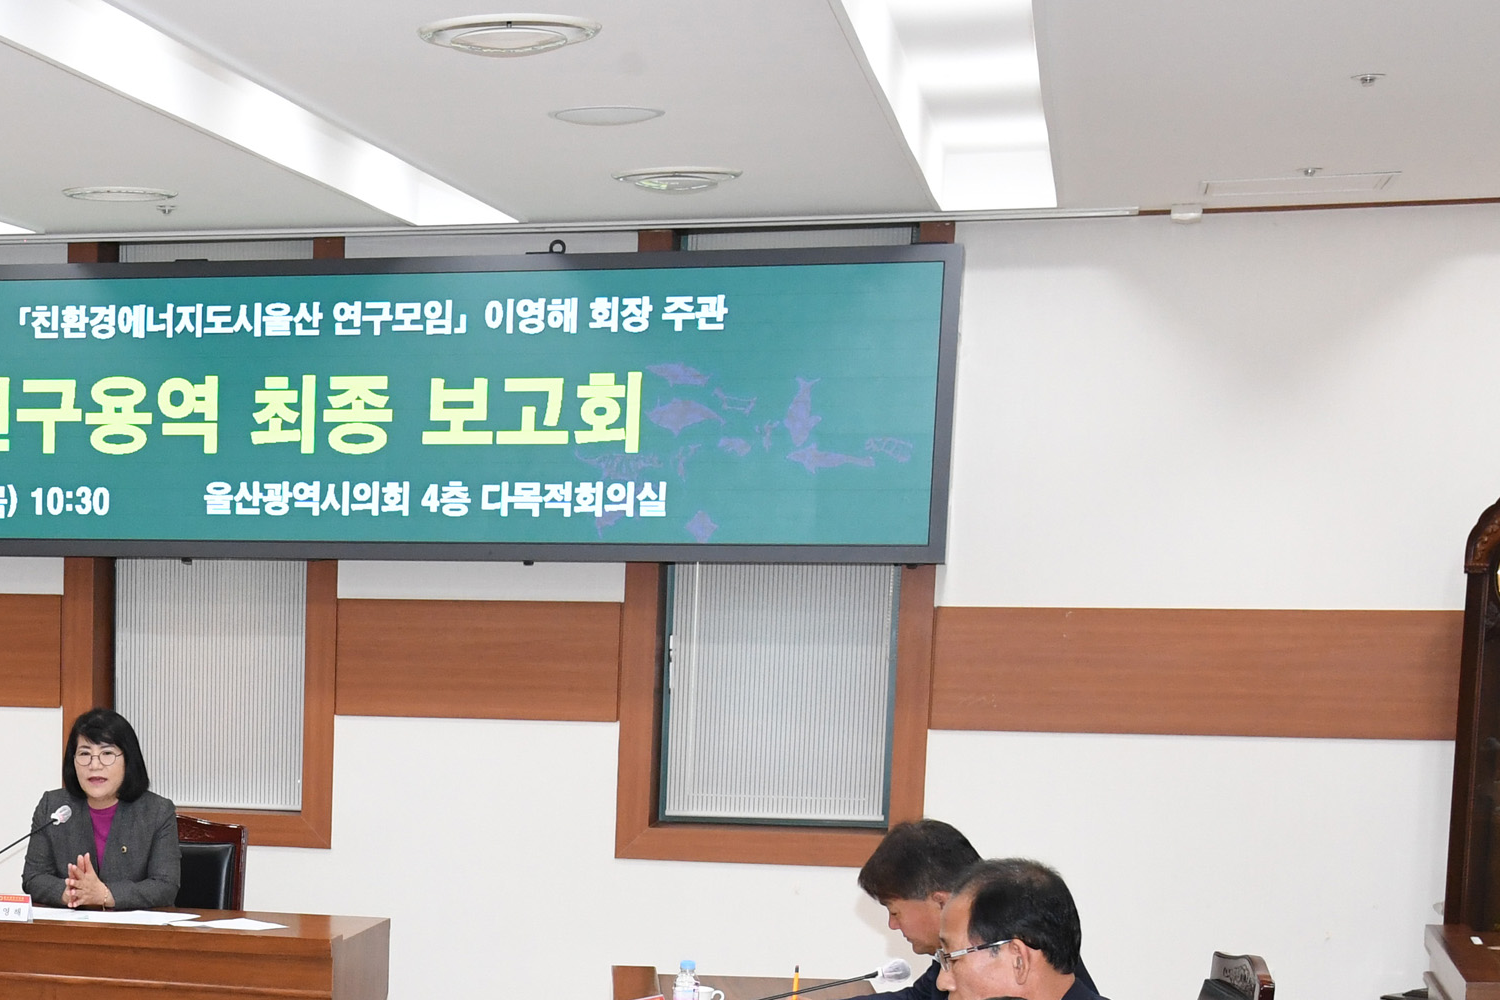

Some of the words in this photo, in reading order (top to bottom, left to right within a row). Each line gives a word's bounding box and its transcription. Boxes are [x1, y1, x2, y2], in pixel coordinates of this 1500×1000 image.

[19, 302, 324, 340] 「친환경에너지도시울산
[332, 300, 467, 336] 연구모임」
[484, 298, 579, 335] 이영해
[588, 296, 653, 333] 회장
[661, 294, 729, 332] 주관
[250, 374, 394, 455] 최종
[421, 371, 643, 454] 보고회
[30, 486, 110, 516] 10:30
[203, 480, 410, 517] 울산광역시의회
[420, 480, 472, 517] 4층
[481, 481, 668, 518] 다목적회의실
